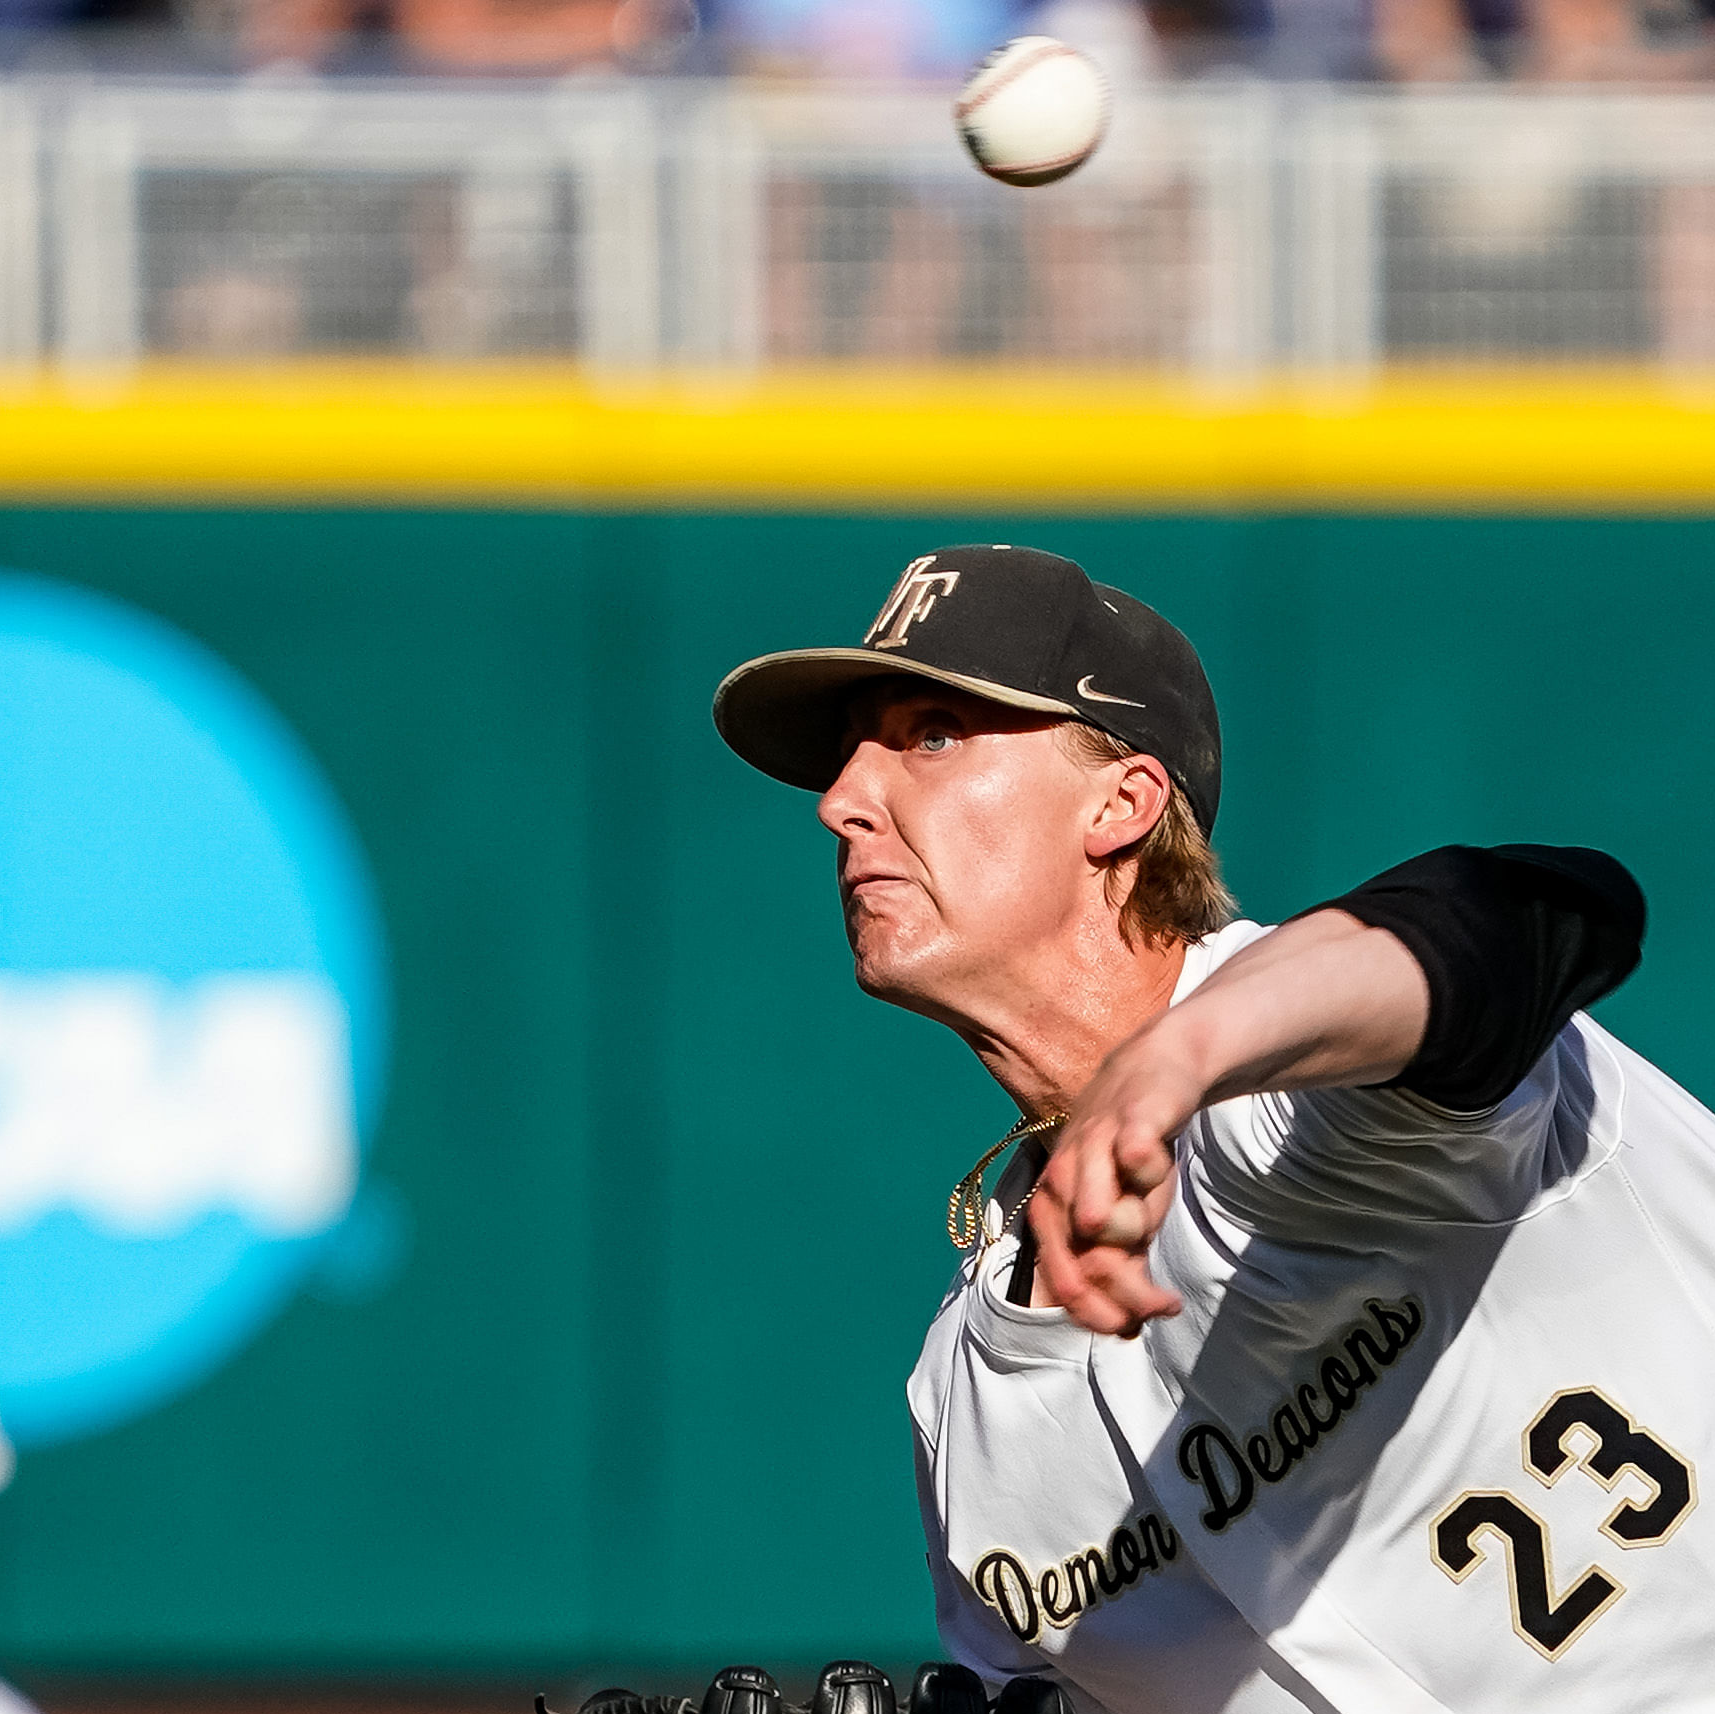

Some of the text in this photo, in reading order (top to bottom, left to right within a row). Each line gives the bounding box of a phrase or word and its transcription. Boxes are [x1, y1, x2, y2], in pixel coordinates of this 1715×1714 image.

[972, 1296, 1425, 1645] Demon Deacons
[1429, 1384, 1699, 1663] 23
